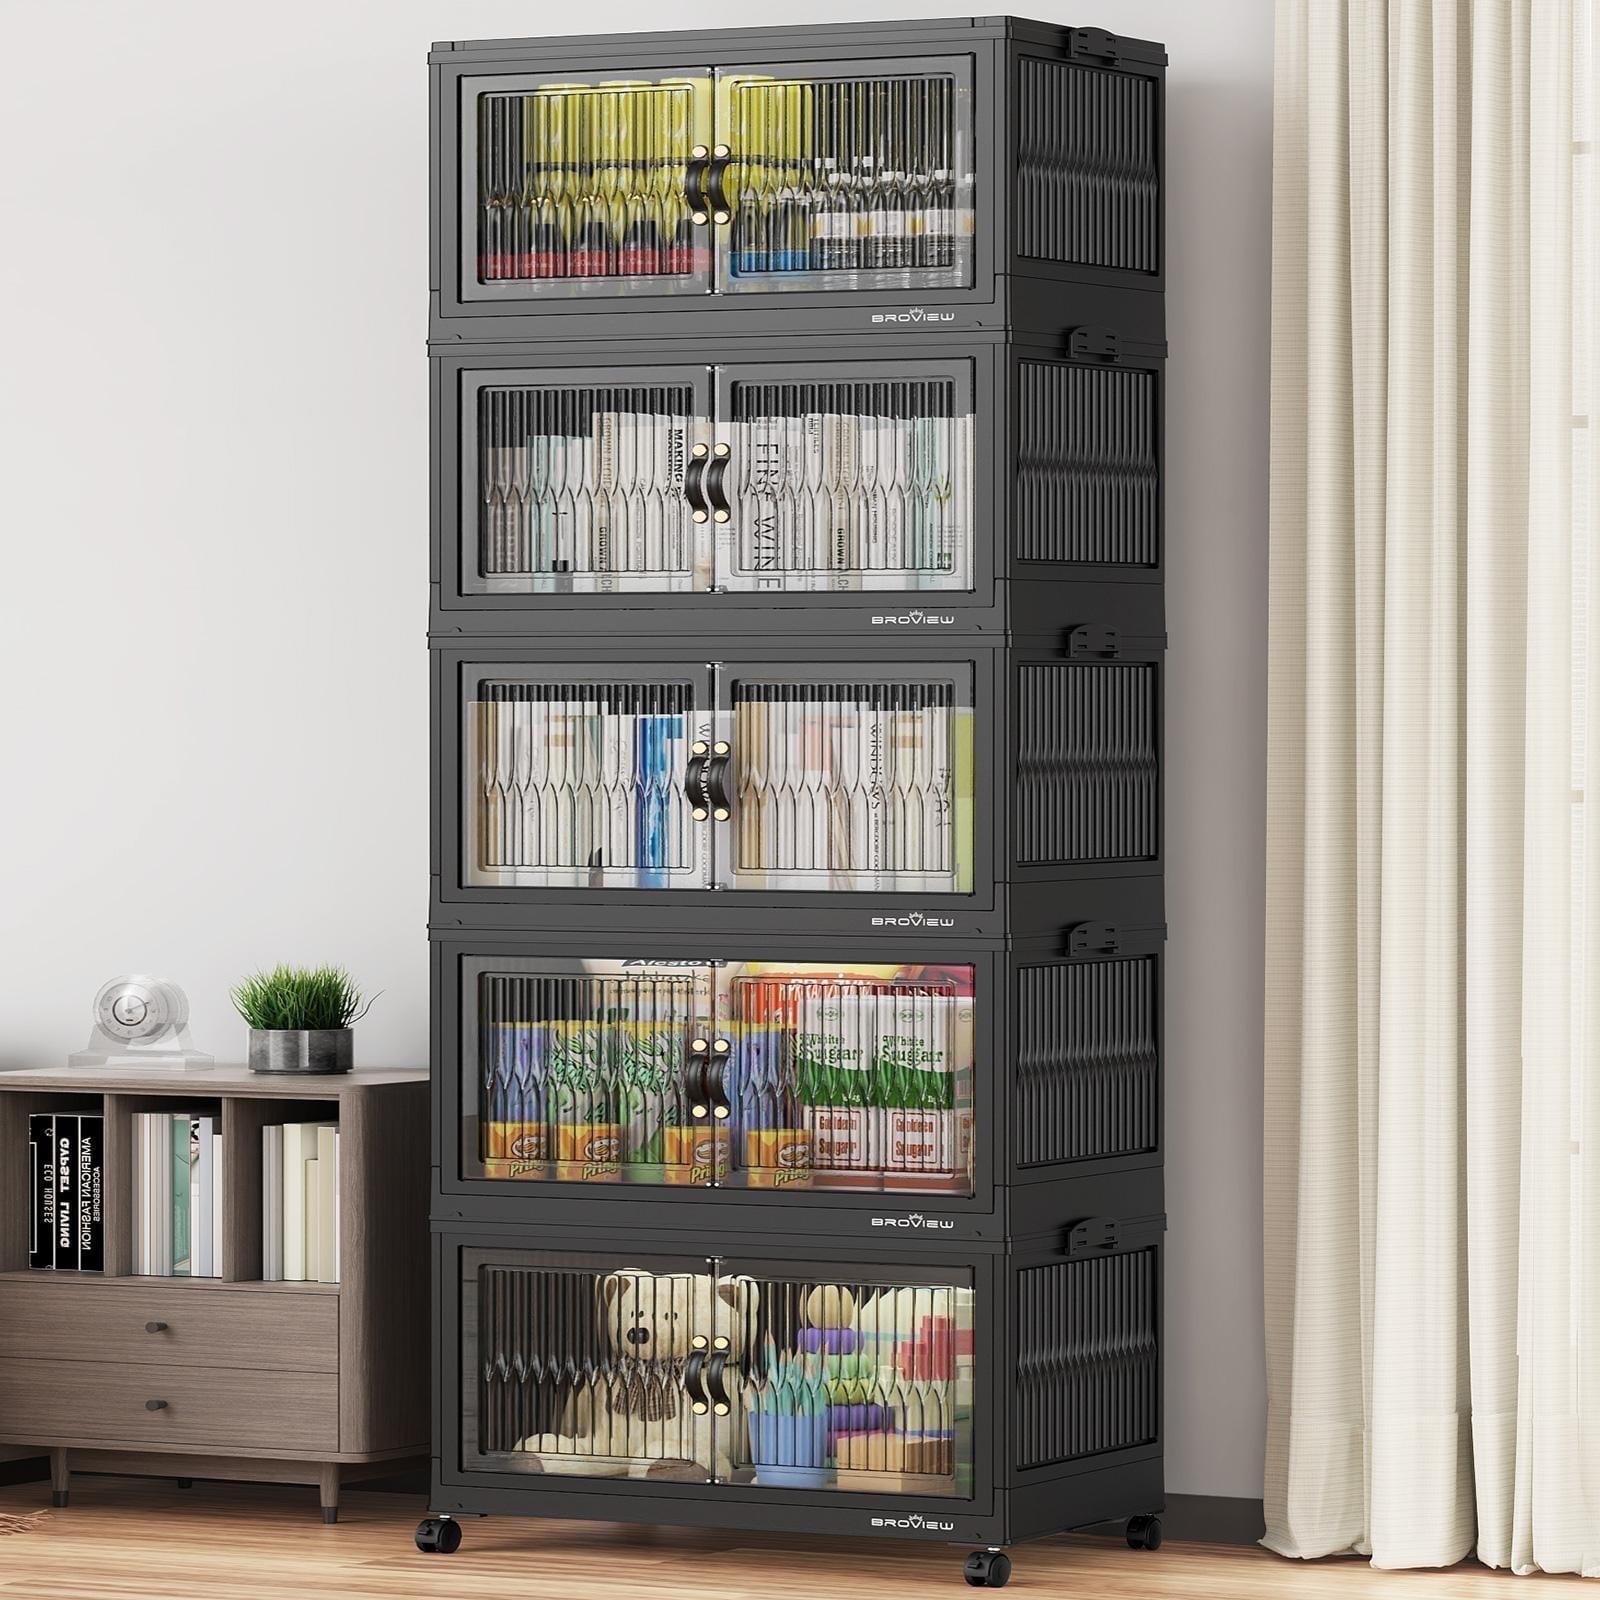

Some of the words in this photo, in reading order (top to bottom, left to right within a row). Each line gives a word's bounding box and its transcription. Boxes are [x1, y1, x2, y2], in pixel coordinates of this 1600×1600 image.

[871, 310, 955, 323] BROVIEW
[672, 429, 684, 483] MAKING
[871, 614, 955, 626] BROVIEW
[871, 915, 954, 928] BROVIEW
[871, 1217, 954, 1230] BROVIEW
[871, 1518, 954, 1531] BROVIEW
